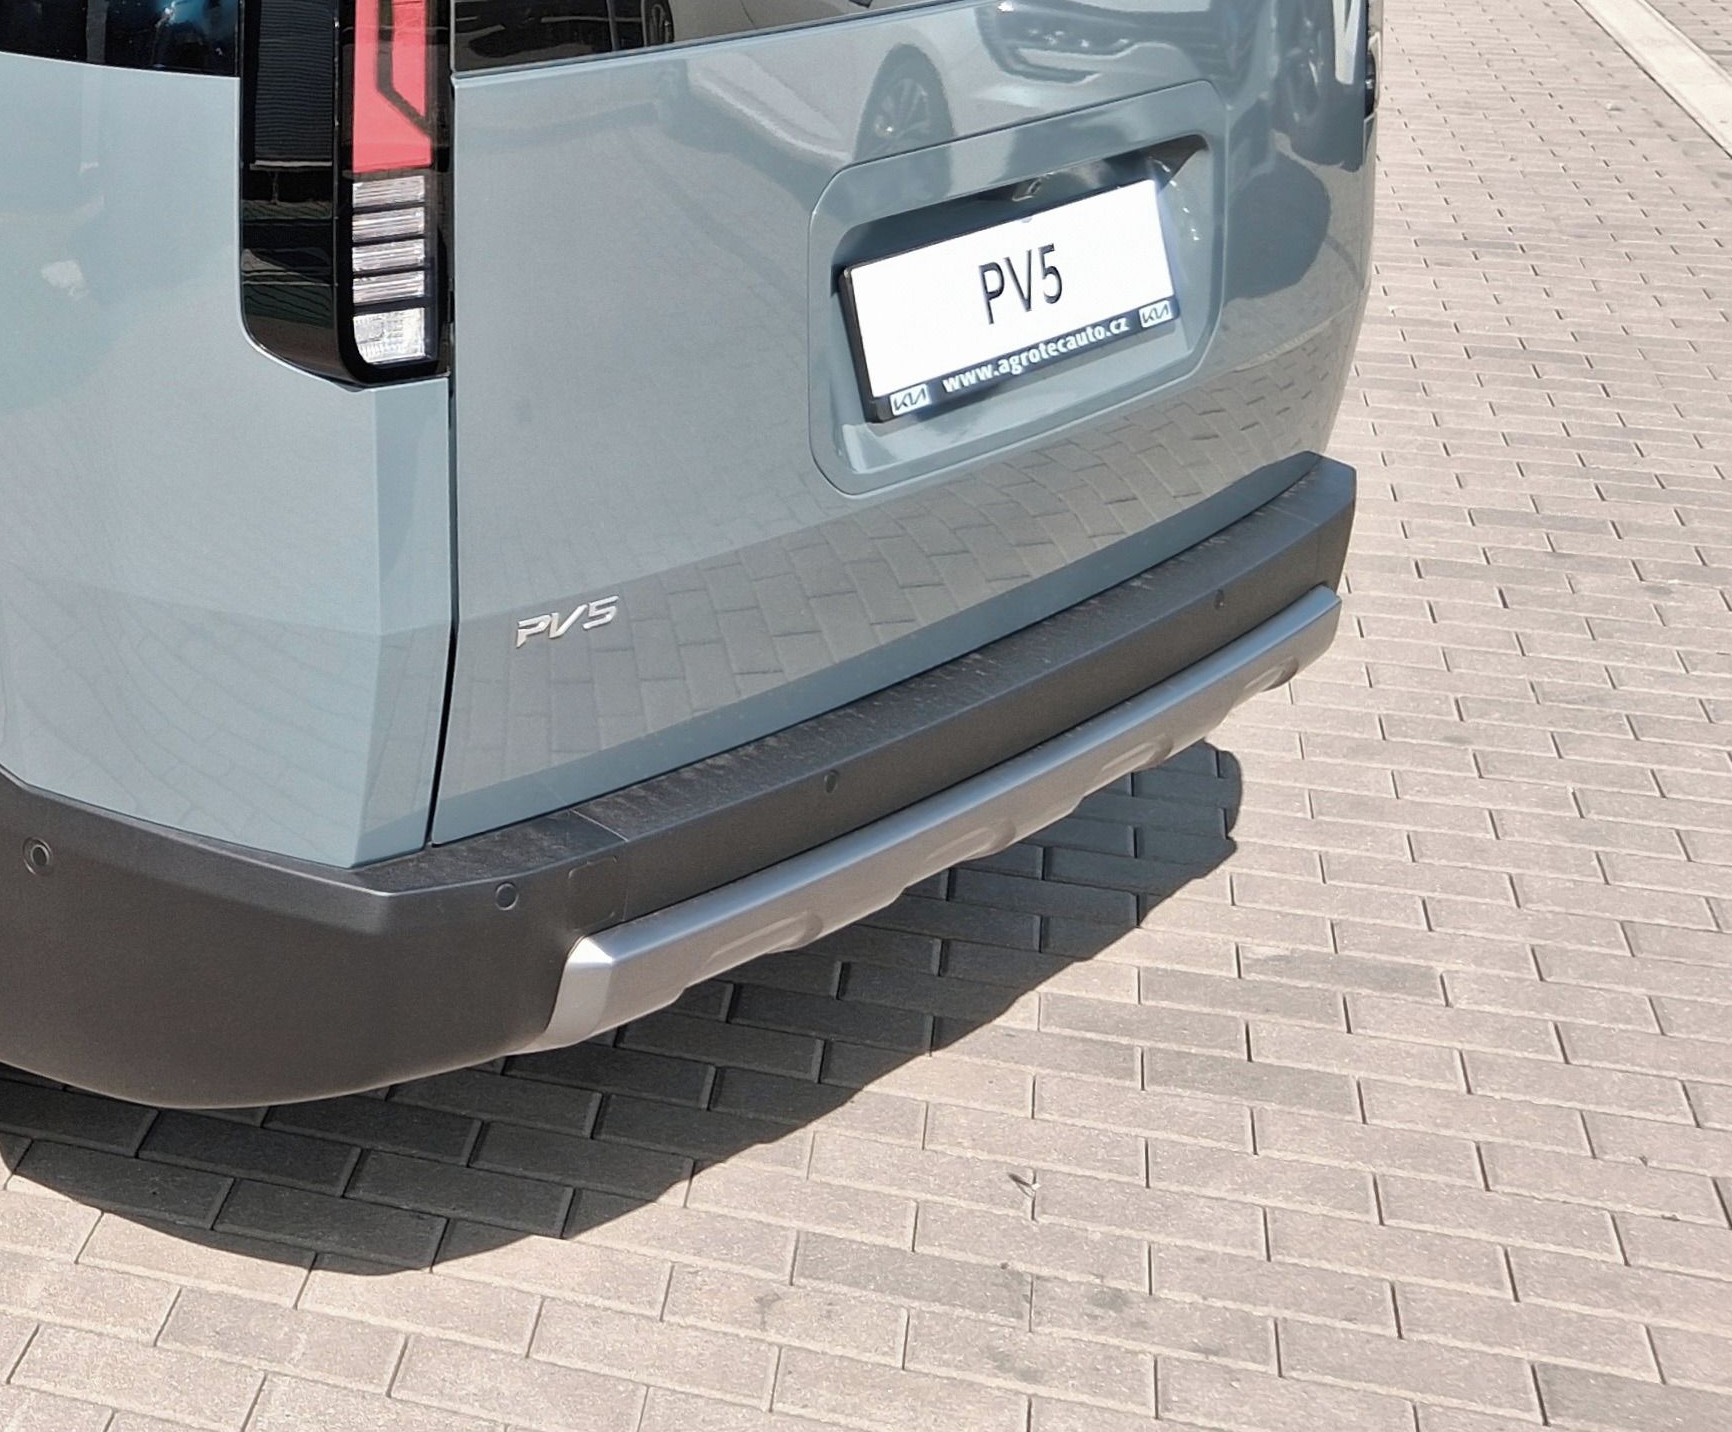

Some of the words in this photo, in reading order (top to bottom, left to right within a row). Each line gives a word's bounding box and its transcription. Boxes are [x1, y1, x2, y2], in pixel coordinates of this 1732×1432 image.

[978, 243, 1063, 325] PV5
[892, 388, 930, 411] KIA
[942, 315, 1131, 393] www.agrotecauto.cz
[1141, 304, 1172, 324] KIA
[516, 595, 619, 649] PV5
